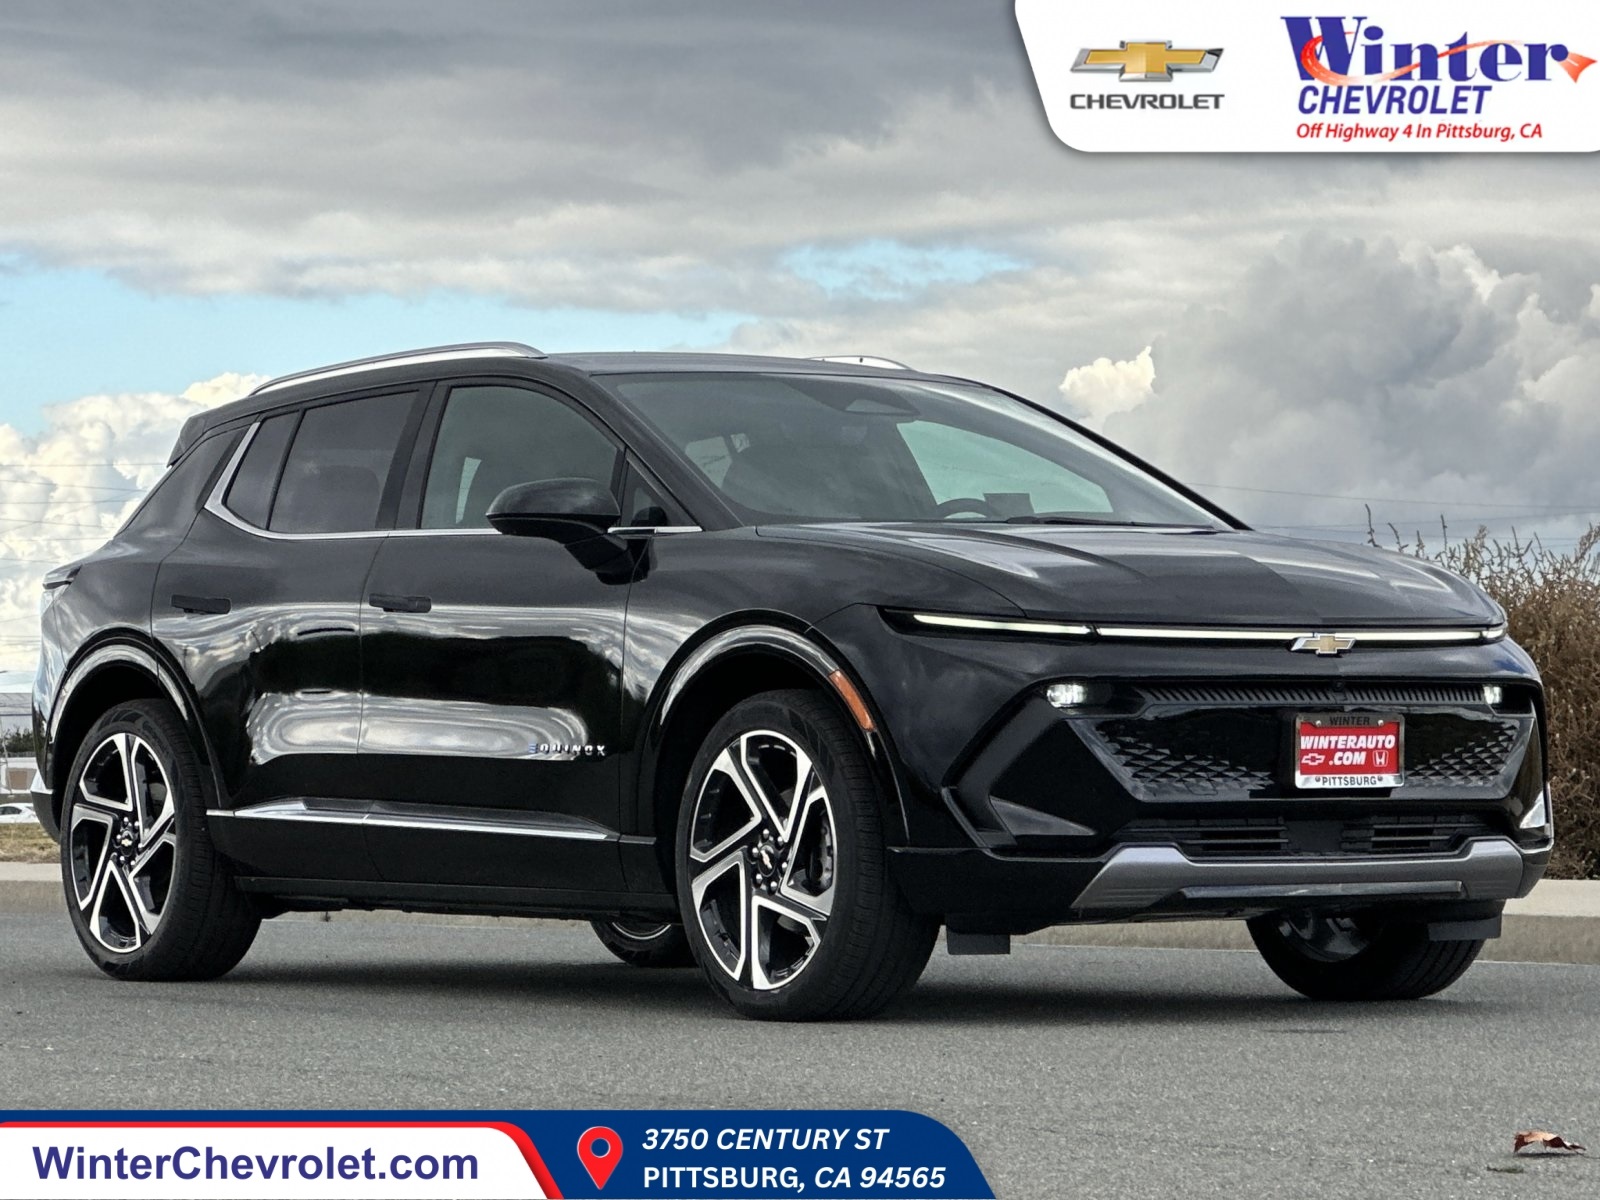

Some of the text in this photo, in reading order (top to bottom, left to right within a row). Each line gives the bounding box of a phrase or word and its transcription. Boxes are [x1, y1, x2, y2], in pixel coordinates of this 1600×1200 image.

[1329, 716, 1370, 726] WINTER
[1301, 735, 1396, 749] WINTERAUTO
[1328, 751, 1367, 766] .COM
[1322, 776, 1377, 786] PITTSBURG
